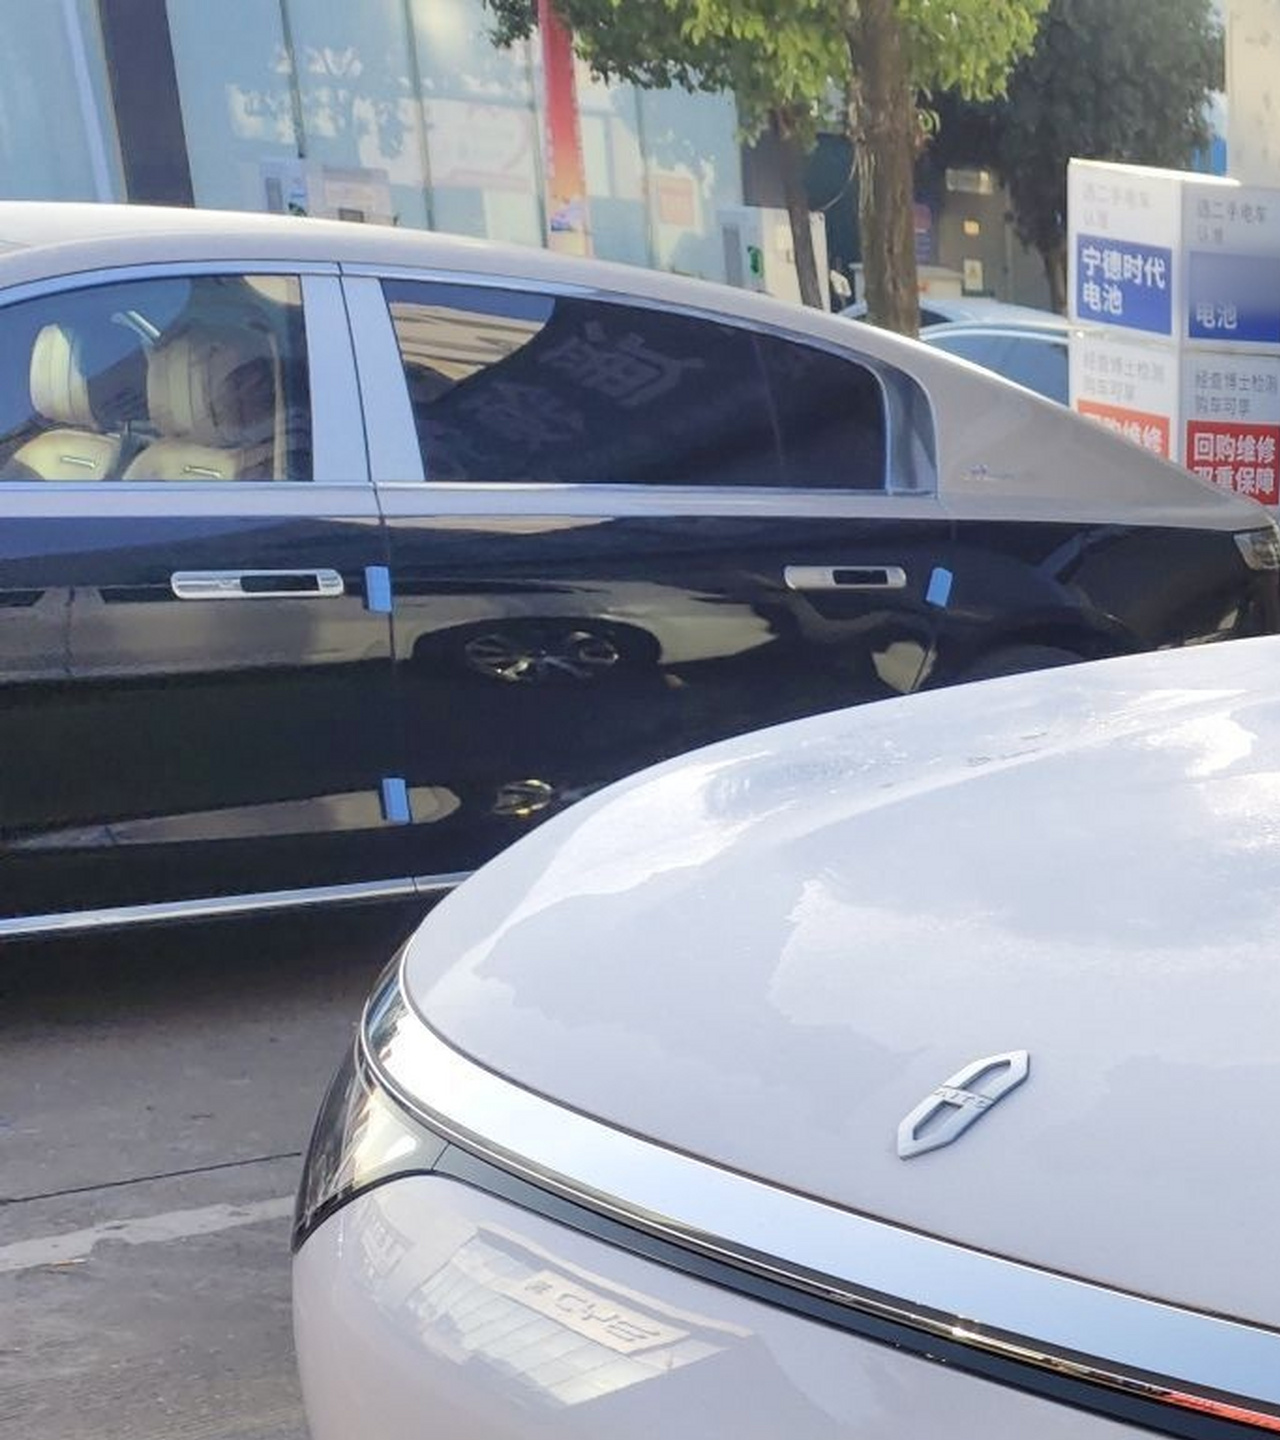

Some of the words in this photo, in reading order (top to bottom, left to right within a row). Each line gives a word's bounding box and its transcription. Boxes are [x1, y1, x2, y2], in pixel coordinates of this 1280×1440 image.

[1081, 245, 1165, 289] 宁德时代
[1082, 280, 1123, 315] 电池
[1196, 300, 1238, 329] 电池
[1193, 432, 1276, 464] 回购维修
